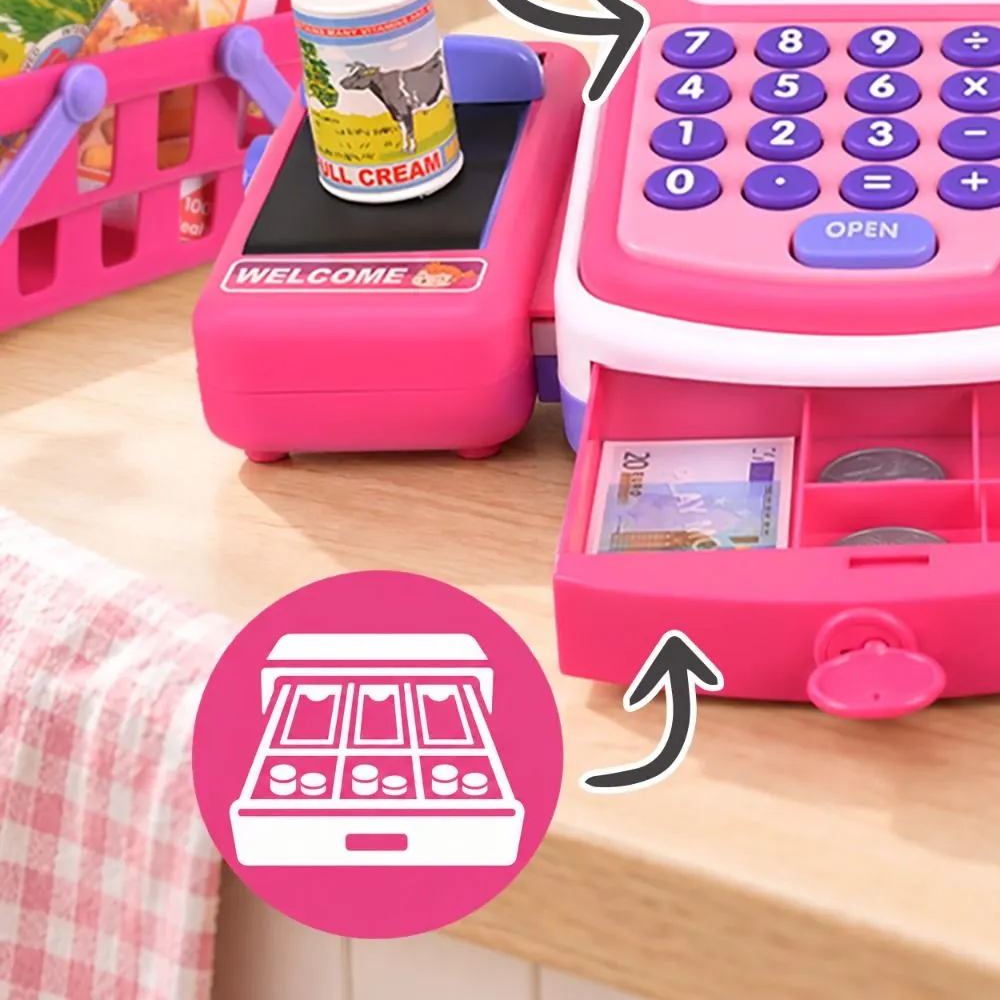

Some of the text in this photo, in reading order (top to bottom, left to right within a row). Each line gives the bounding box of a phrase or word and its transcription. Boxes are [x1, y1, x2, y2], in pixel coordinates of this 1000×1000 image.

[684, 30, 710, 54] 7
[778, 28, 803, 53] 8
[871, 29, 897, 54] 9
[677, 74, 705, 99] 4
[774, 73, 800, 98] 5
[869, 74, 895, 98] 6
[678, 120, 693, 145] 1
[770, 120, 796, 145] 2
[868, 120, 893, 147] 3
[358, 151, 442, 187] CREAM
[666, 168, 695, 195] 0
[825, 220, 899, 239] OPEN
[234, 267, 409, 286] WELCOME
[622, 451, 651, 470] 20
